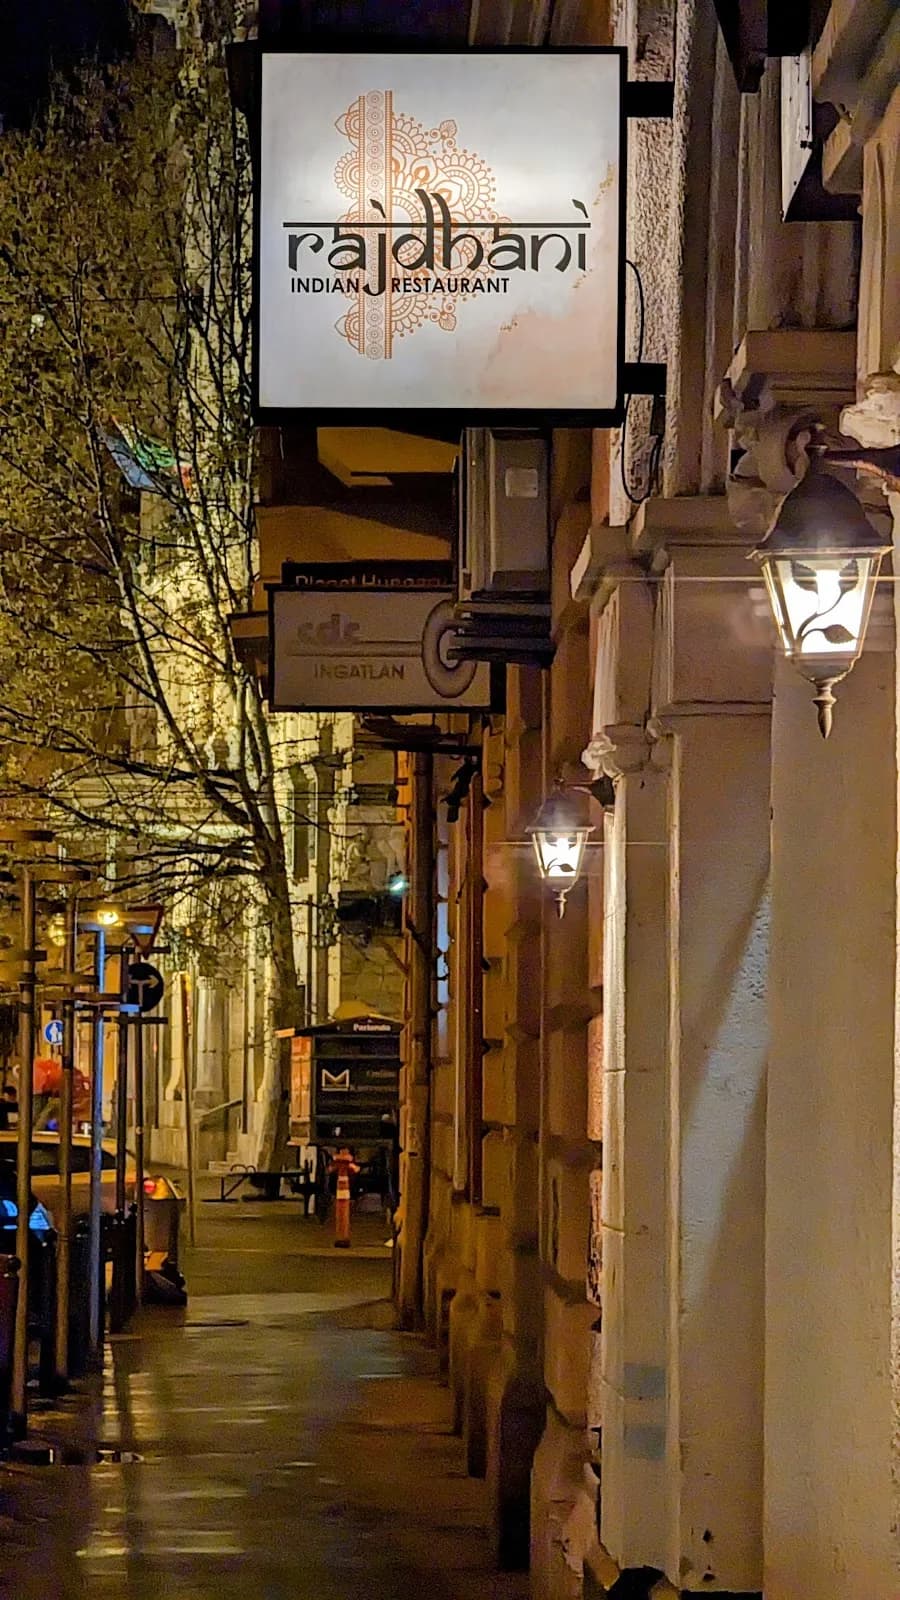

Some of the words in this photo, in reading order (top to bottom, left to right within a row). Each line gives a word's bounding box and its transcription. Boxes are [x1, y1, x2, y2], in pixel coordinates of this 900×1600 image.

[285, 189, 590, 296] rajdhani
[290, 277, 360, 294] INDIAN
[391, 277, 510, 294] RESTAURANT
[314, 663, 405, 680] INGATLAN
